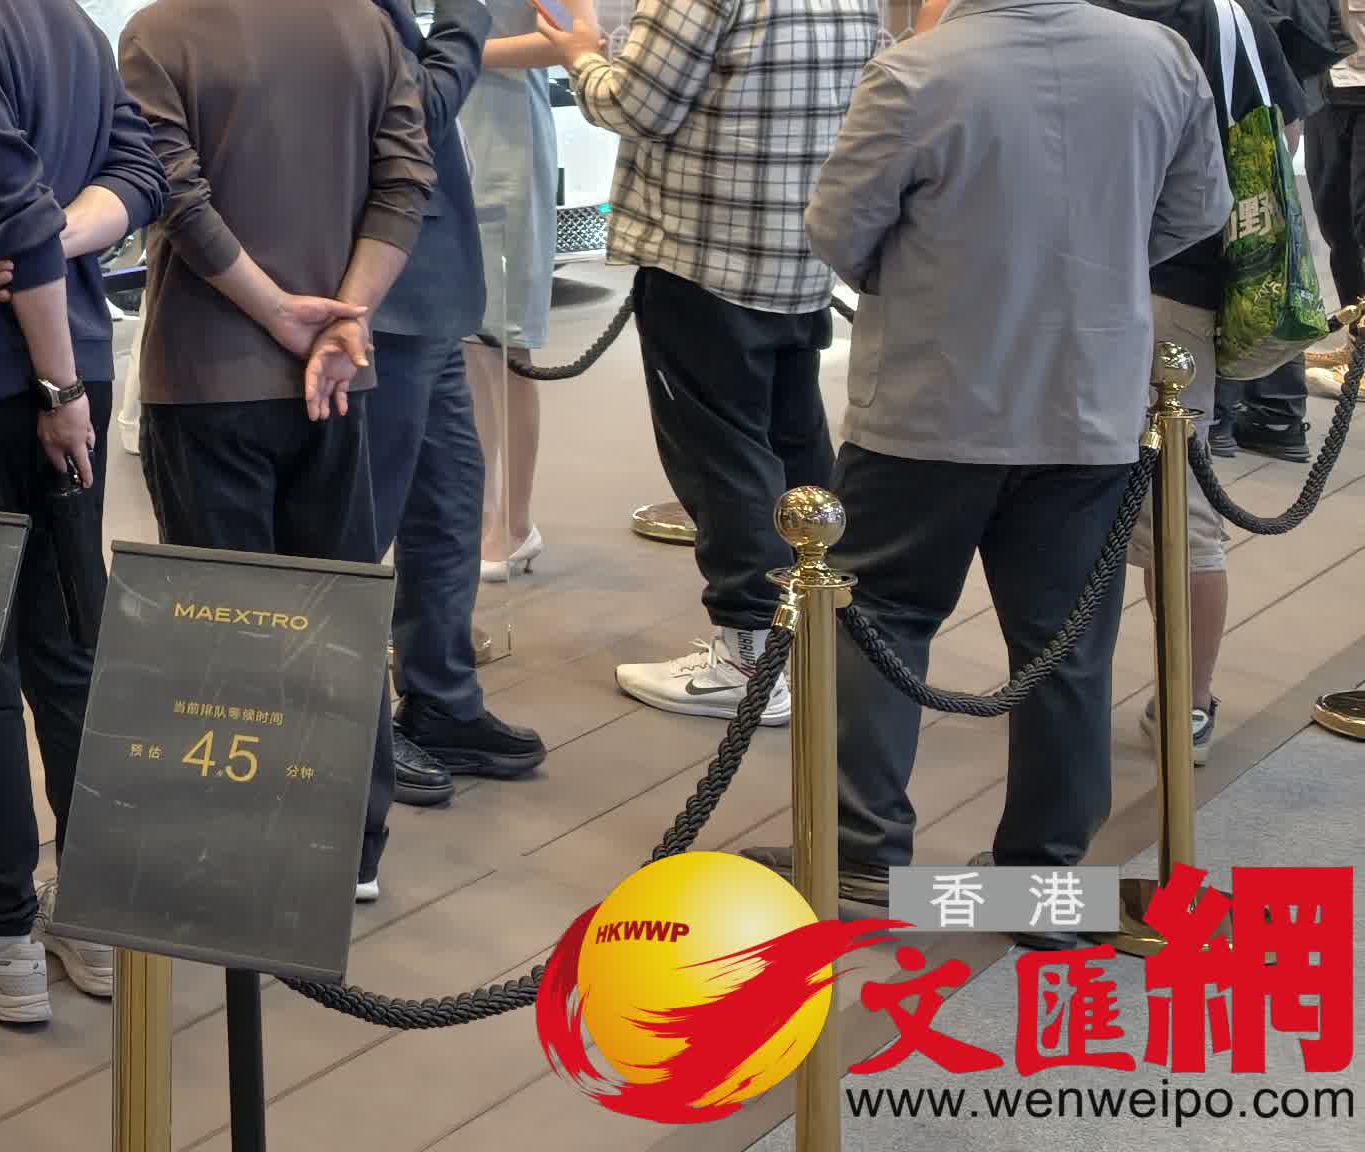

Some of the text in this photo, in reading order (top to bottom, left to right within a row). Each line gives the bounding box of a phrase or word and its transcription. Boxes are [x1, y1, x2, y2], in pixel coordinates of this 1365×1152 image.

[174, 601, 309, 631] MAEXTRO
[182, 729, 260, 782] 45
[285, 764, 315, 780] 分钟
